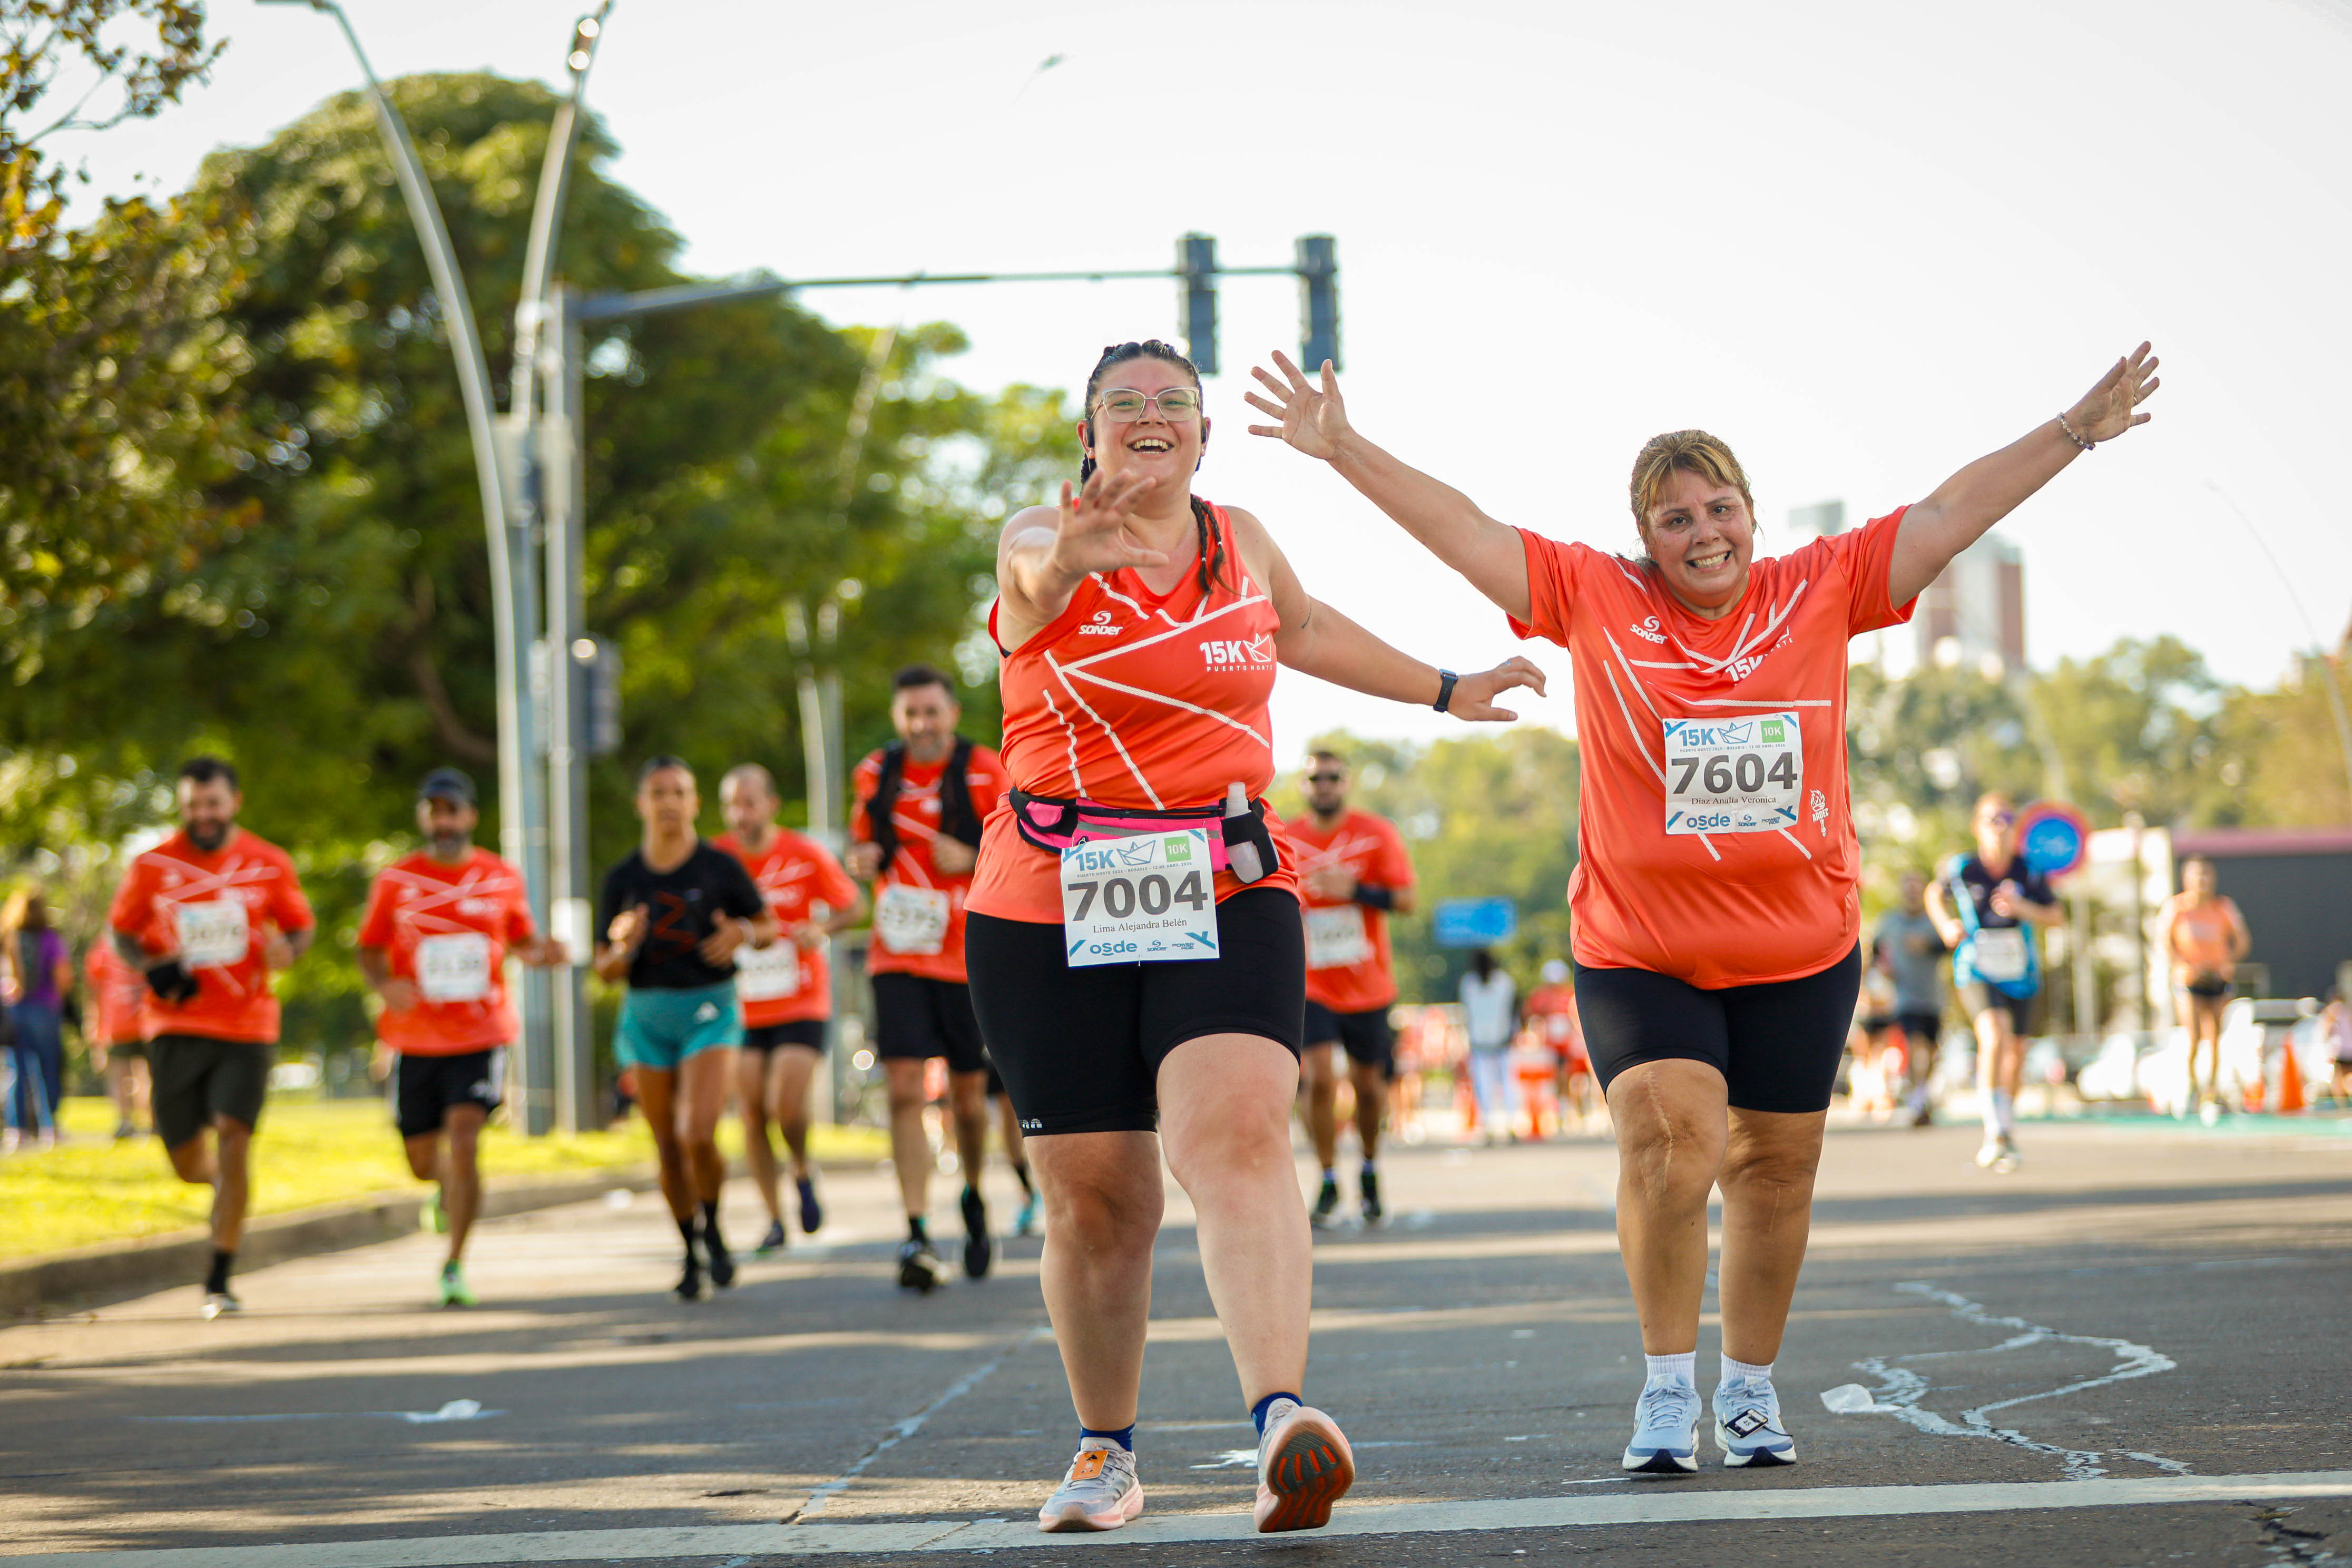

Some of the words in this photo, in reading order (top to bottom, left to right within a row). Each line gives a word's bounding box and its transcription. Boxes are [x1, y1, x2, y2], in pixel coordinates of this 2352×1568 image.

[1200, 640, 1246, 664] 15K
[1679, 728, 1716, 747] 15K
[1763, 726, 1782, 736] 10K
[1671, 752, 1798, 794] 7604
[1687, 813, 1731, 830] osde
[1812, 807, 1829, 822] ARDEC
[1167, 843, 1188, 855] 10K
[1076, 849, 1115, 871] 15K
[1067, 870, 1208, 922] 7004
[1119, 920, 1160, 933] Alejandra
[1162, 918, 1187, 928] Belén
[1090, 940, 1138, 956] osde
